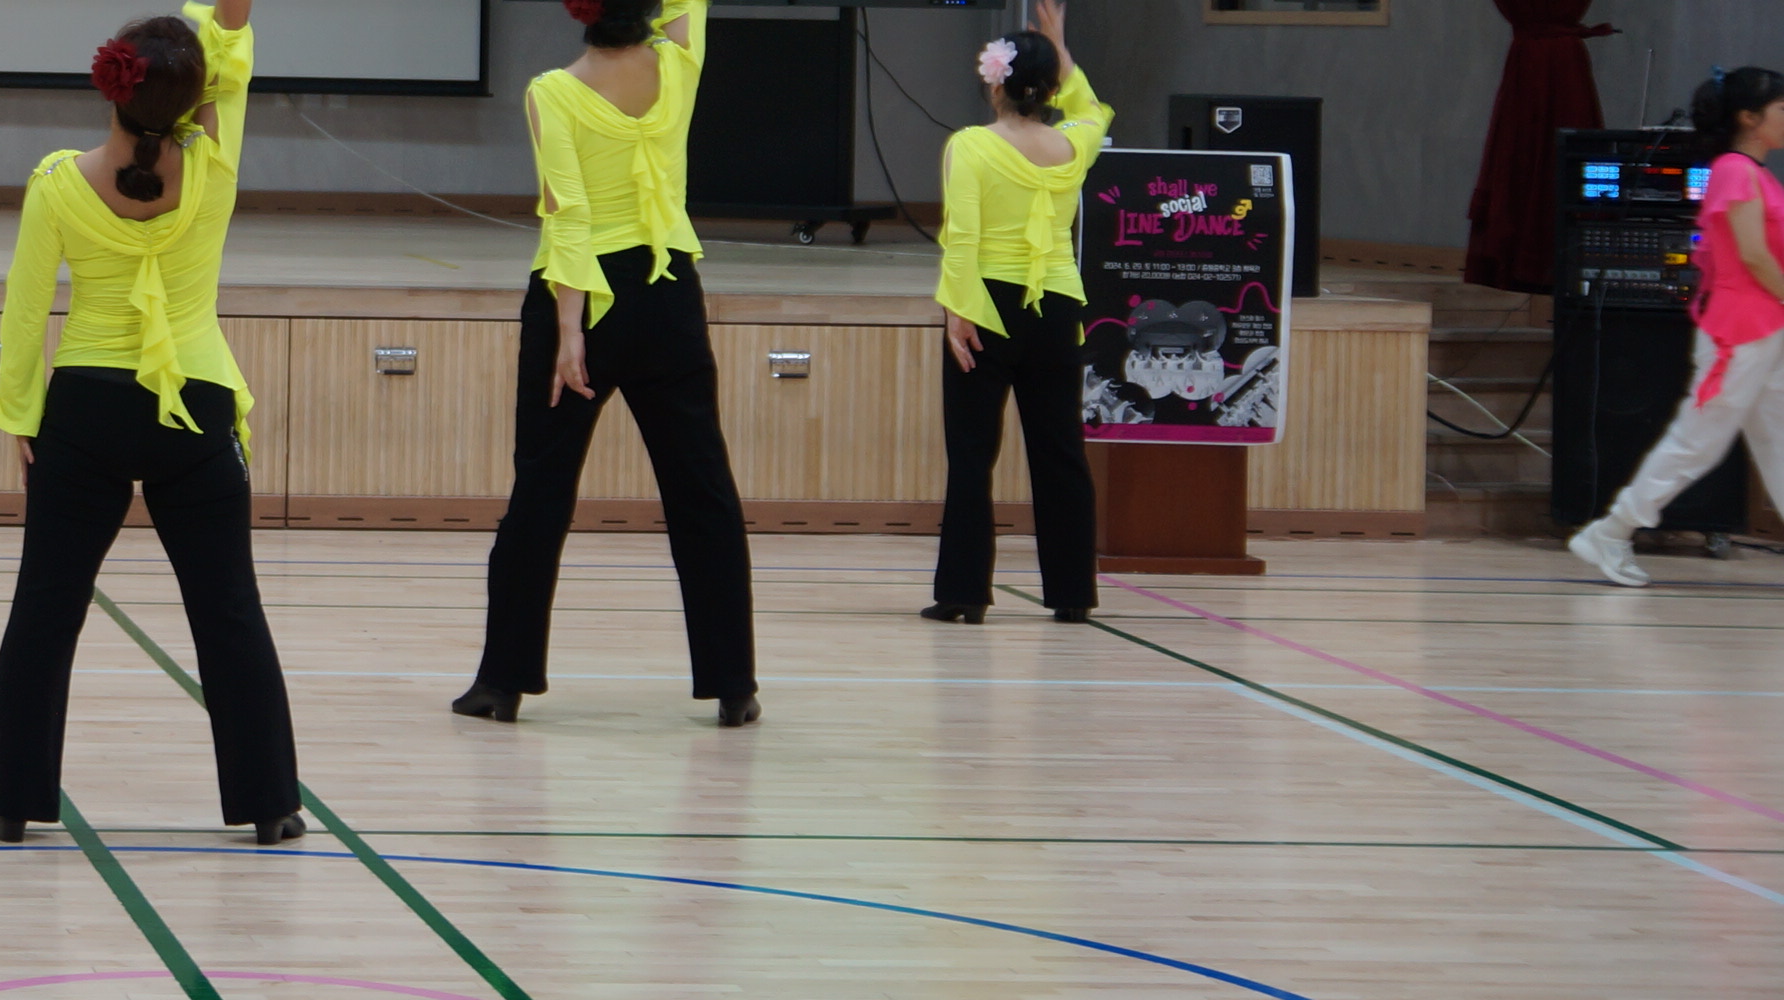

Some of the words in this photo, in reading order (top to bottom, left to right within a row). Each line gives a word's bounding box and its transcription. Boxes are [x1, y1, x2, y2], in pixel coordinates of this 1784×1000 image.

[1147, 176, 1188, 198] shall
[1194, 183, 1218, 197] we
[1159, 190, 1208, 218] social
[1114, 209, 1165, 247] LINE
[1173, 211, 1245, 242] DANCE
